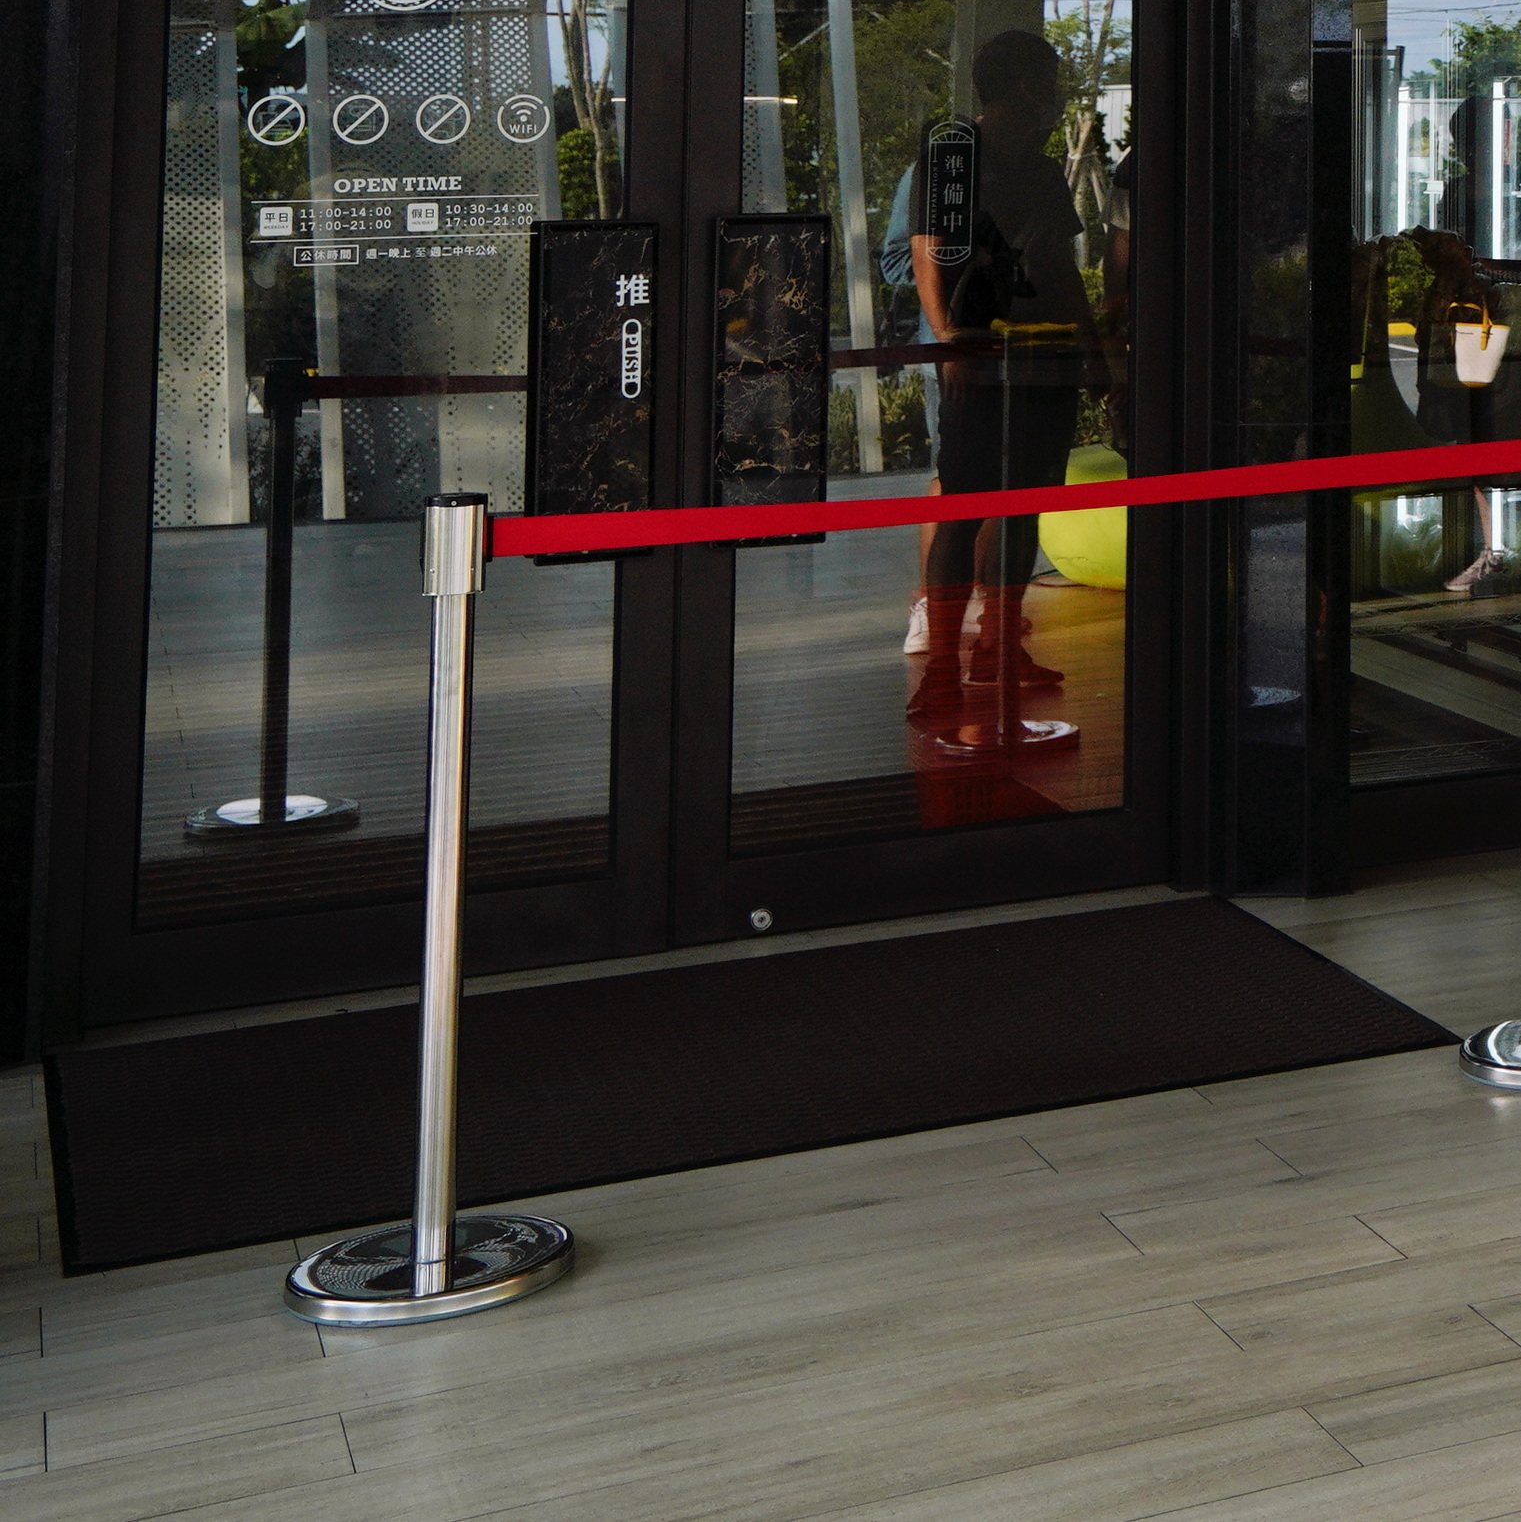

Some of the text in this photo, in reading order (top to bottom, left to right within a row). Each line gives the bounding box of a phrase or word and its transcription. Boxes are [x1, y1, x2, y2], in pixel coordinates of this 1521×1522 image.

[509, 124, 538, 134] WIFI
[333, 176, 462, 194] OPEN TIME
[943, 155, 965, 233] 準備中
[300, 206, 392, 219] 11:00-14:00
[411, 208, 435, 219] 假日
[445, 203, 534, 215] 10:30-14:00
[264, 212, 289, 224] 平日
[445, 215, 534, 228] 17:00-21:00
[300, 219, 392, 232] 17:00-21:00
[300, 248, 352, 261] 公休時間
[365, 247, 411, 260] 週一晚上
[430, 244, 498, 257] 週二中午公休
[615, 273, 650, 307] 推
[623, 333, 641, 383] PUSH
